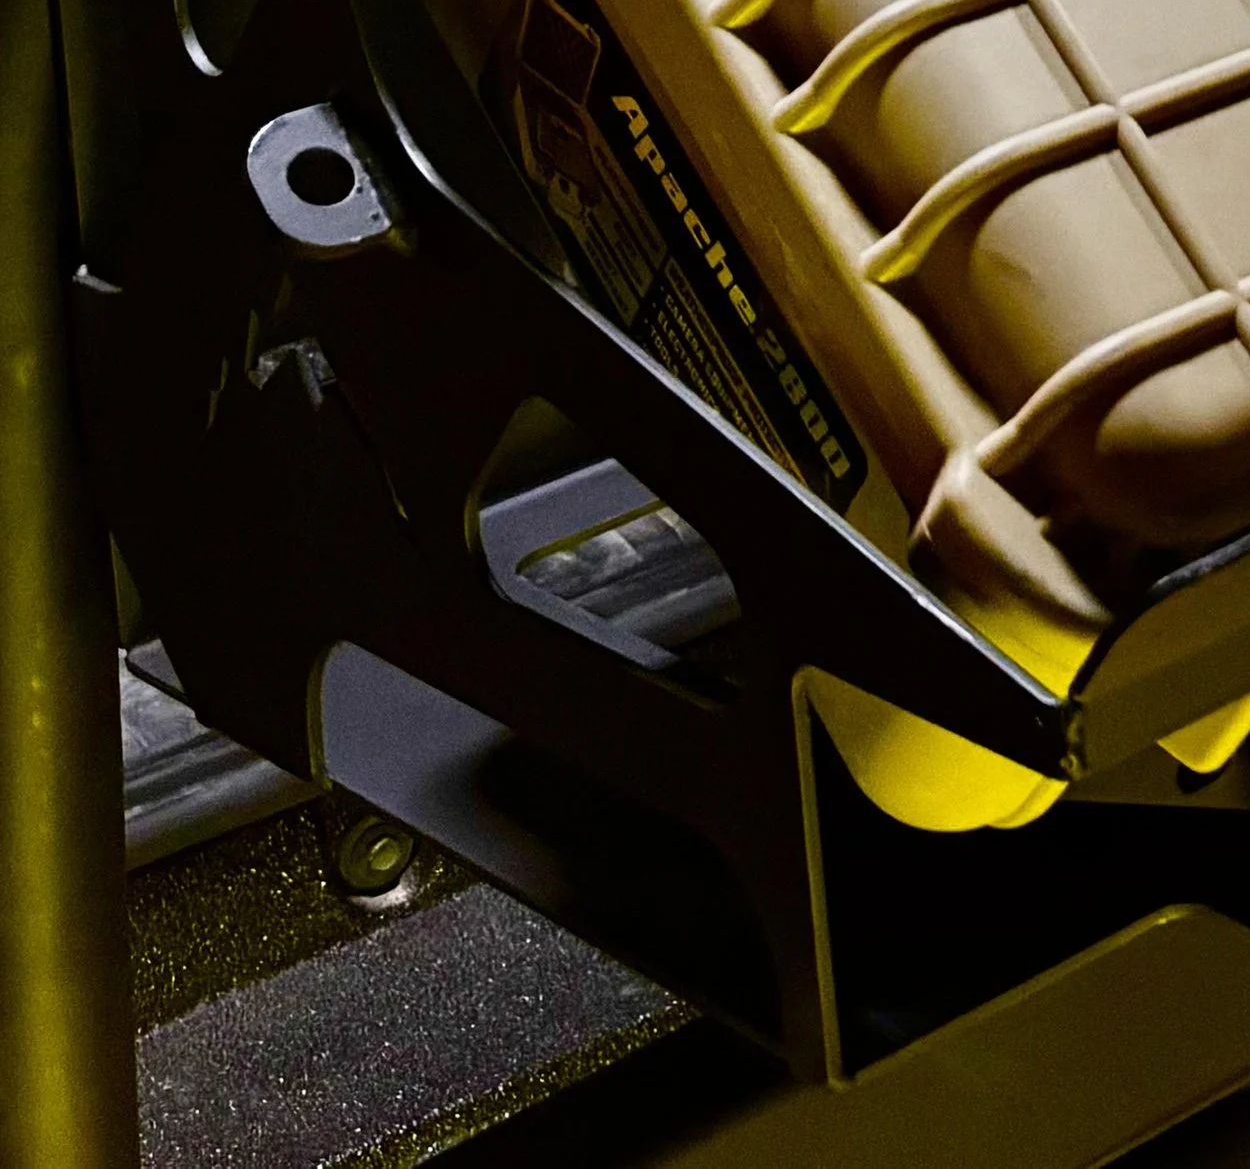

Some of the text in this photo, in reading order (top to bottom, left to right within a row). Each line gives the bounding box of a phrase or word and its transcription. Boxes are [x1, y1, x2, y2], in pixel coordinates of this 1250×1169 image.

[611, 95, 757, 326] Apache
[756, 327, 851, 479] 2800
[664, 293, 705, 364] CAMERA
